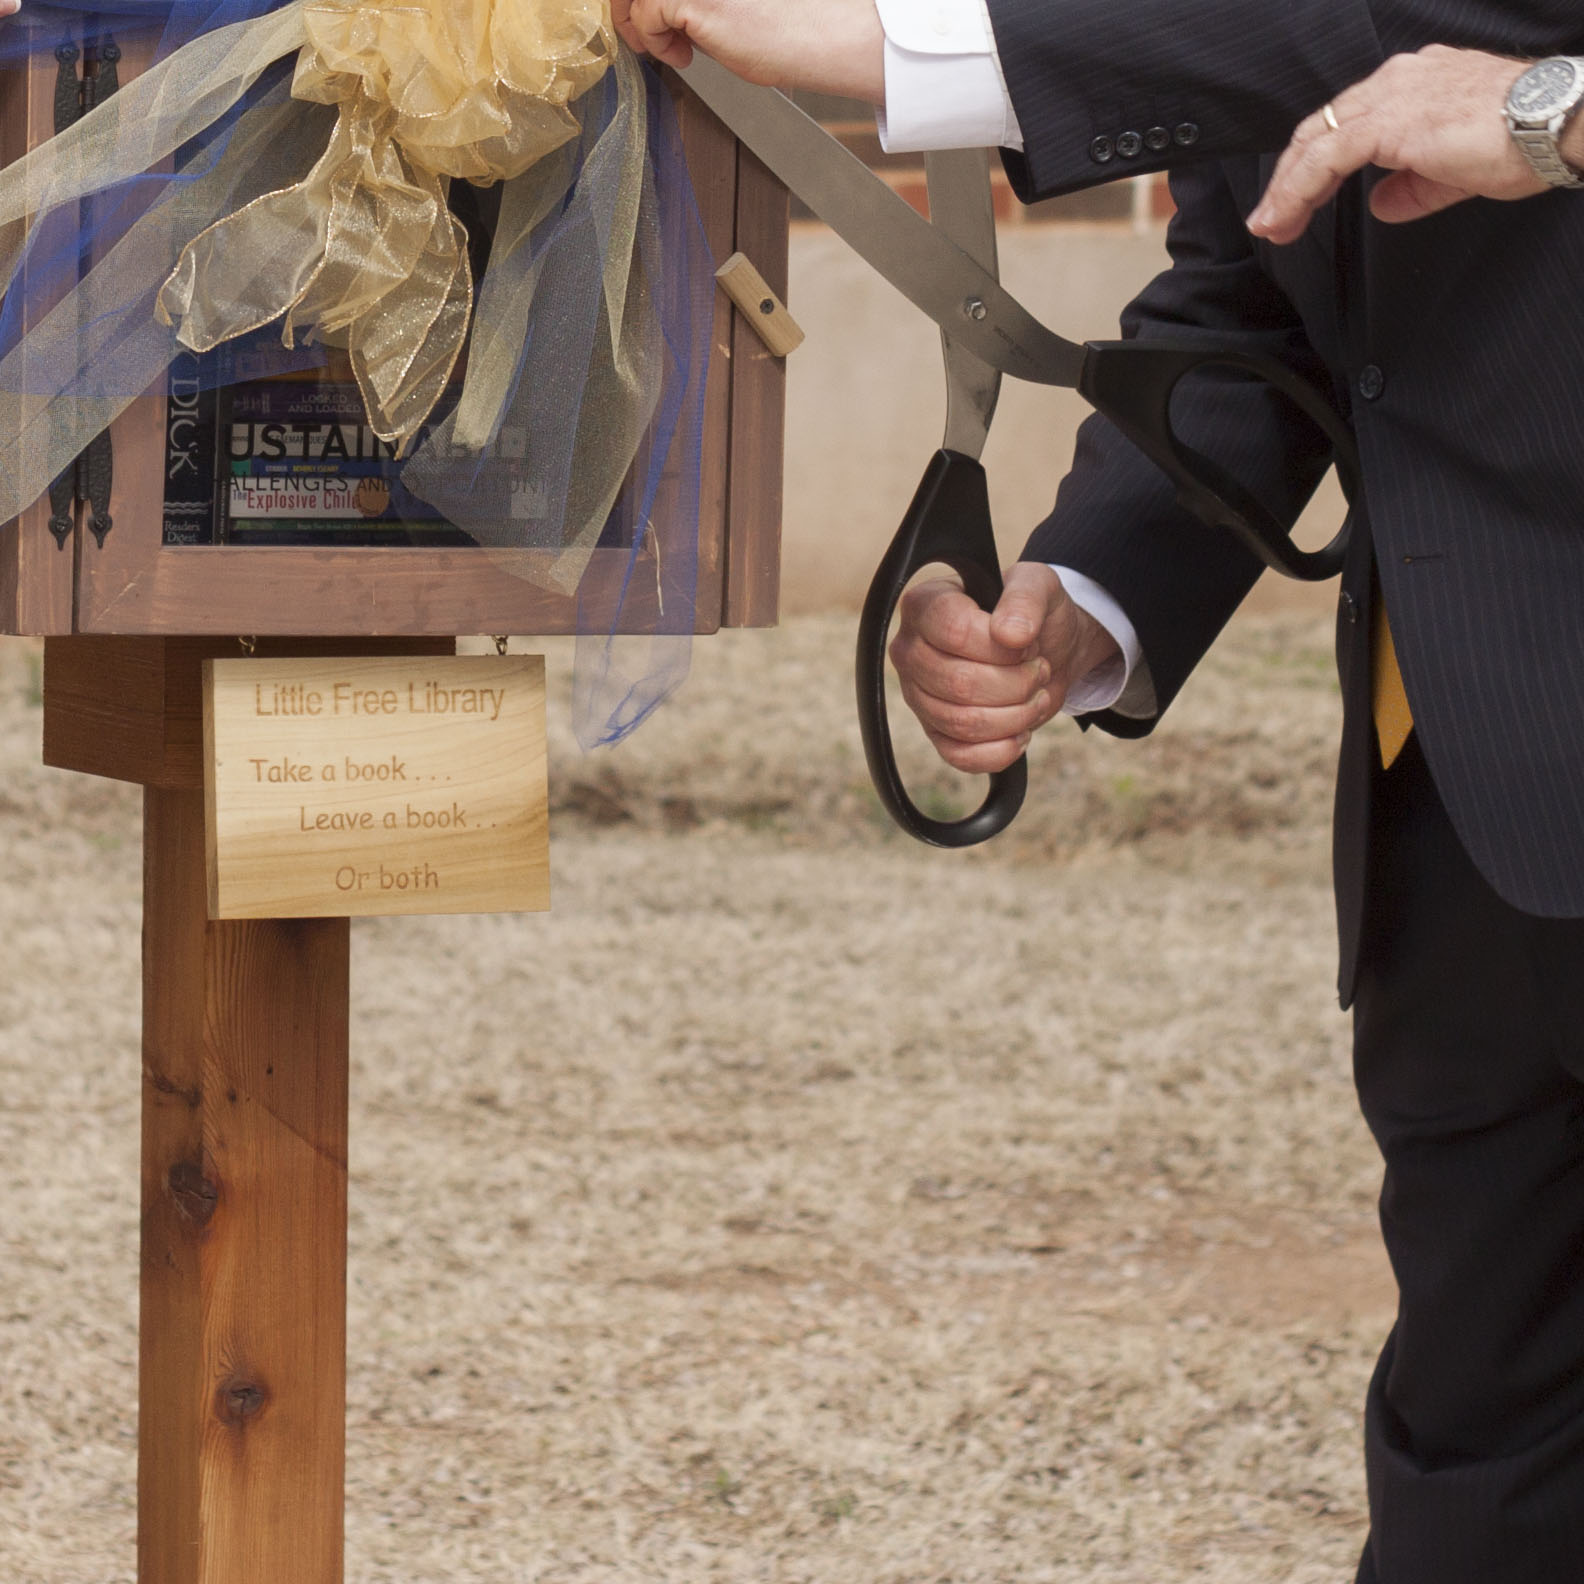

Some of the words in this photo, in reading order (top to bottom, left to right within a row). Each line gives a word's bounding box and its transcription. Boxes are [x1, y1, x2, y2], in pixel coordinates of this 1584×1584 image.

[288, 404, 313, 414] AND
[316, 404, 362, 414] LOADED
[169, 376, 200, 480] DICK
[356, 475, 392, 493] AND
[232, 489, 248, 501] The
[248, 489, 317, 512] Explosive
[255, 683, 323, 717] Little
[333, 682, 398, 715] Free
[408, 681, 505, 720] Library
[248, 757, 313, 783] Take
[321, 762, 336, 782] a
[345, 755, 407, 781] book
[300, 806, 373, 832] Leave
[383, 814, 397, 831] a
[406, 802, 466, 829] book
[335, 866, 368, 891] Or
[379, 863, 439, 890] both
